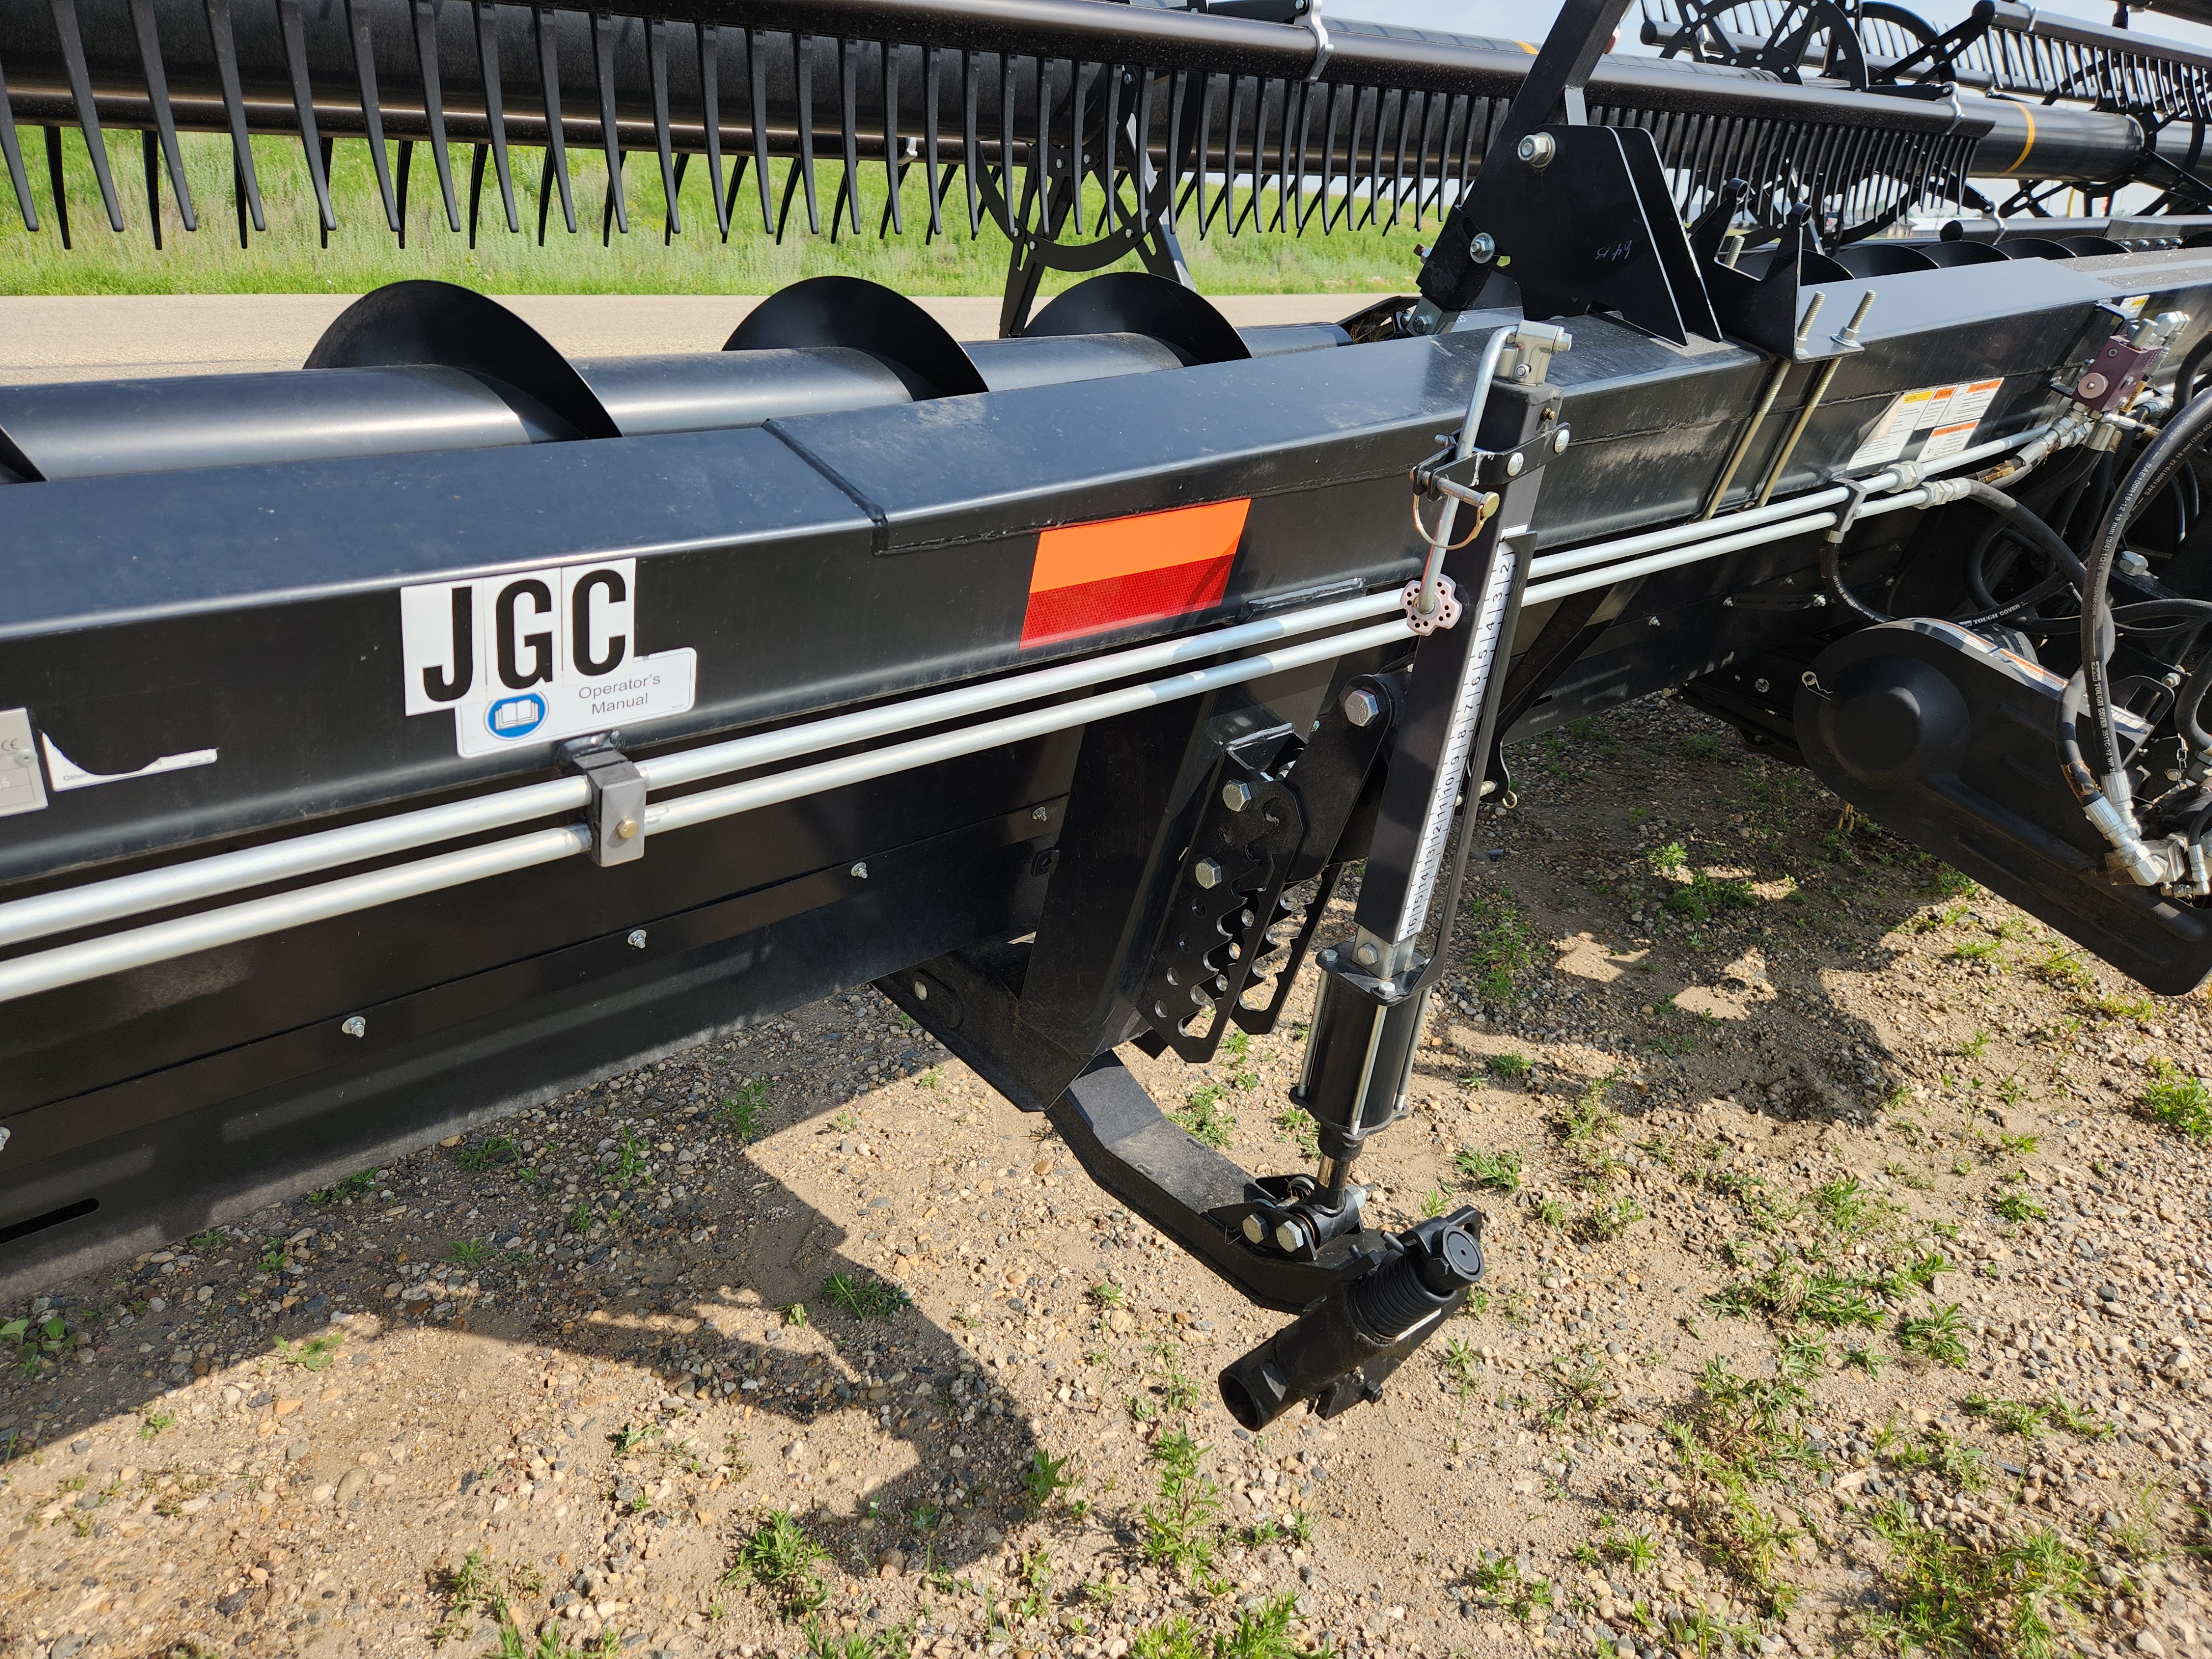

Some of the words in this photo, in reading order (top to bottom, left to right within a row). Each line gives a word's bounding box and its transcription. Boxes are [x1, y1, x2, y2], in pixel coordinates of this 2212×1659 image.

[2144, 459, 2177, 495] SAE100R19-12
[2182, 443, 2193, 453] mm
[2190, 431, 2204, 443] (3/4)
[2119, 462, 2152, 512] SAE100R19-12
[2109, 521, 2117, 535] mm
[2103, 536, 2113, 551] (3/4)
[1500, 562, 1511, 573] 2
[1493, 591, 1503, 602] 3
[1973, 613, 1999, 625] TOUGH
[1999, 604, 2021, 616] COVER
[1486, 620, 1495, 630] 4
[422, 568, 627, 702] JGC
[1478, 649, 1488, 659] 5
[2091, 661, 2101, 681] Parker
[579, 674, 661, 700] Operator's
[1471, 676, 1480, 686] 6
[2094, 682, 2104, 706] TOUGH
[592, 693, 648, 714] Manual
[1464, 703, 1473, 713] 7
[2098, 707, 2107, 728] COVER
[1457, 729, 1467, 740] 8
[2102, 729, 2112, 757] 351TC-12
[1451, 755, 1459, 765] 9
[2107, 757, 2115, 767] WP
[1443, 776, 1454, 795] 10
[1437, 802, 1447, 818] 11
[1431, 824, 1442, 842] 12
[1425, 848, 1436, 867] 13
[1418, 873, 1429, 890] 14
[1412, 895, 1423, 914] 15
[1406, 917, 1417, 935] 16
